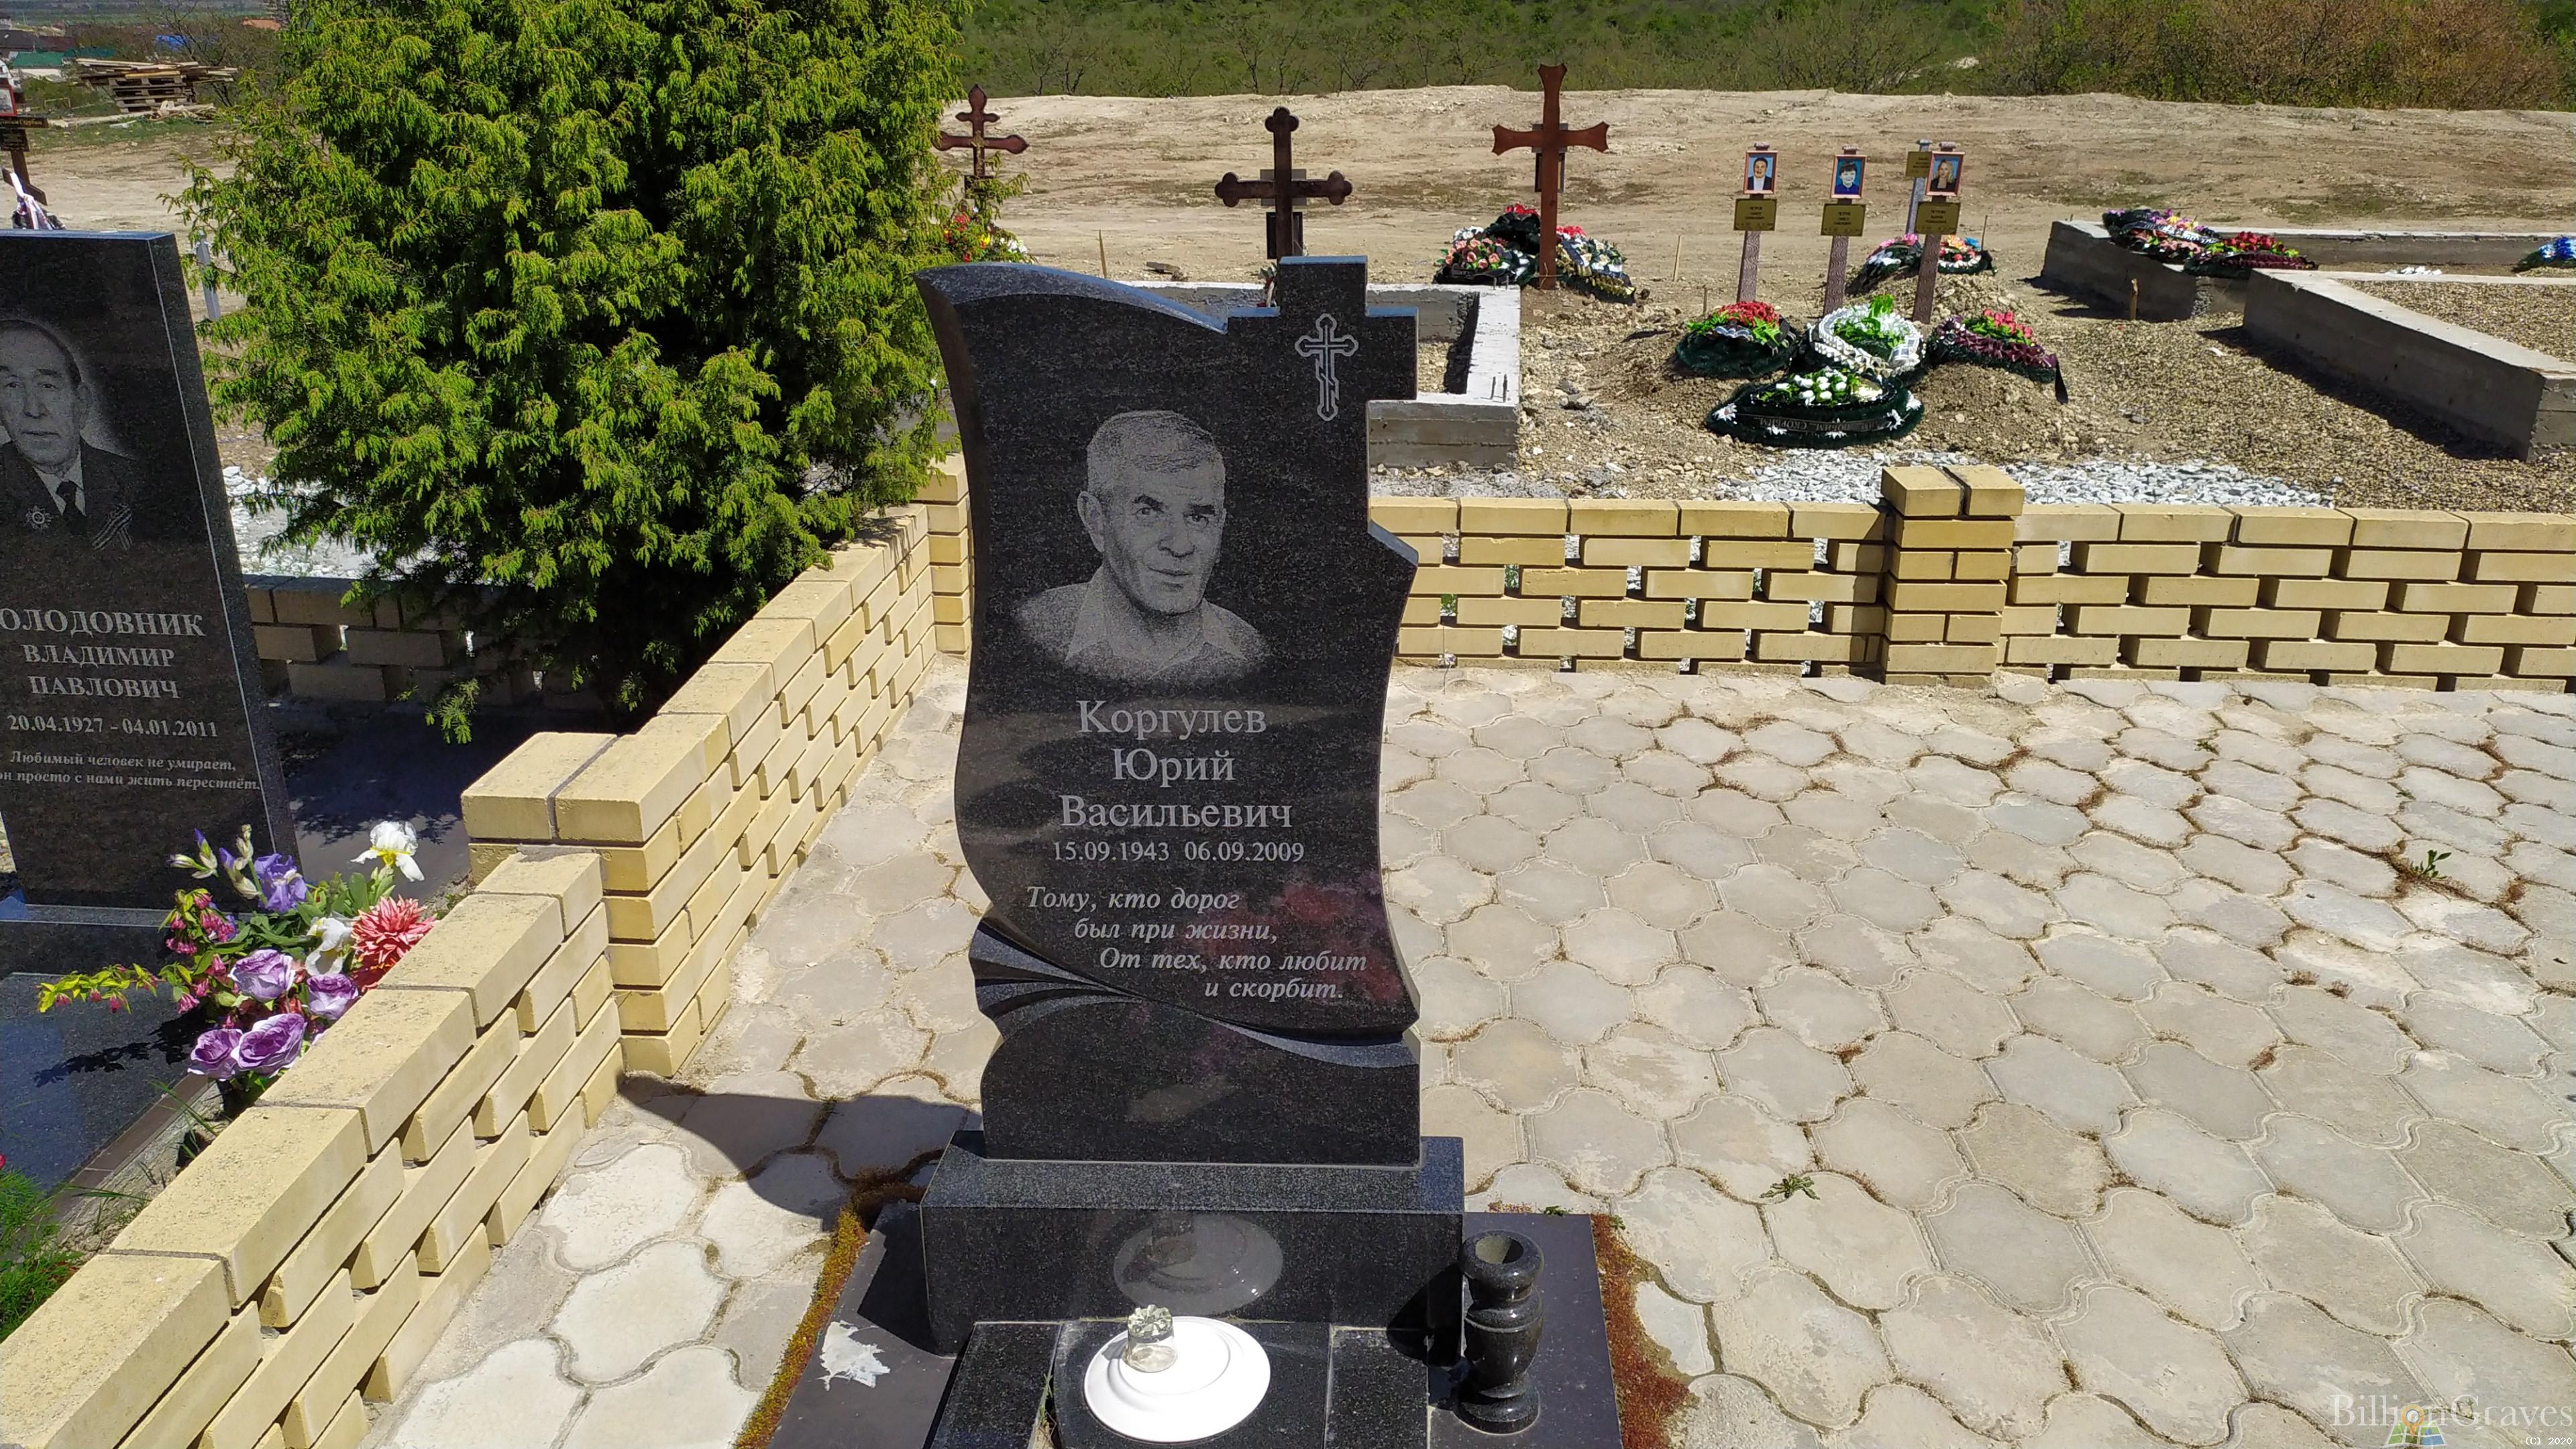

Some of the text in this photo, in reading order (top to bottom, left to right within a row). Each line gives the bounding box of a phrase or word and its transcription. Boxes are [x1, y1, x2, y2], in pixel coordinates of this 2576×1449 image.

[0, 607, 207, 638] ОЛОДОВНИК
[21, 644, 174, 669] ВЛАДИМИР
[28, 676, 181, 699] ПАВЛОВИЧ
[7, 714, 103, 733] 20.04.1927
[122, 718, 218, 737] 04.01.2011
[1076, 700, 1267, 740] Коргулев
[10, 751, 236, 772] Любимый человек не умирает,
[1112, 747, 1236, 788] Юрий
[17, 772, 70, 784] просто
[74, 774, 82, 784] с
[87, 774, 123, 785] нами
[127, 776, 172, 788] жить
[1059, 794, 1293, 829] Васильевич
[1053, 841, 1305, 863] 15.09.1943 06.09.2009
[1027, 886, 1240, 914] Тому, кто дорог
[1074, 917, 1277, 944] был при жизни,
[1099, 947, 1367, 973] От тех, кто любит
[1204, 977, 1343, 1003] и скорбит.
